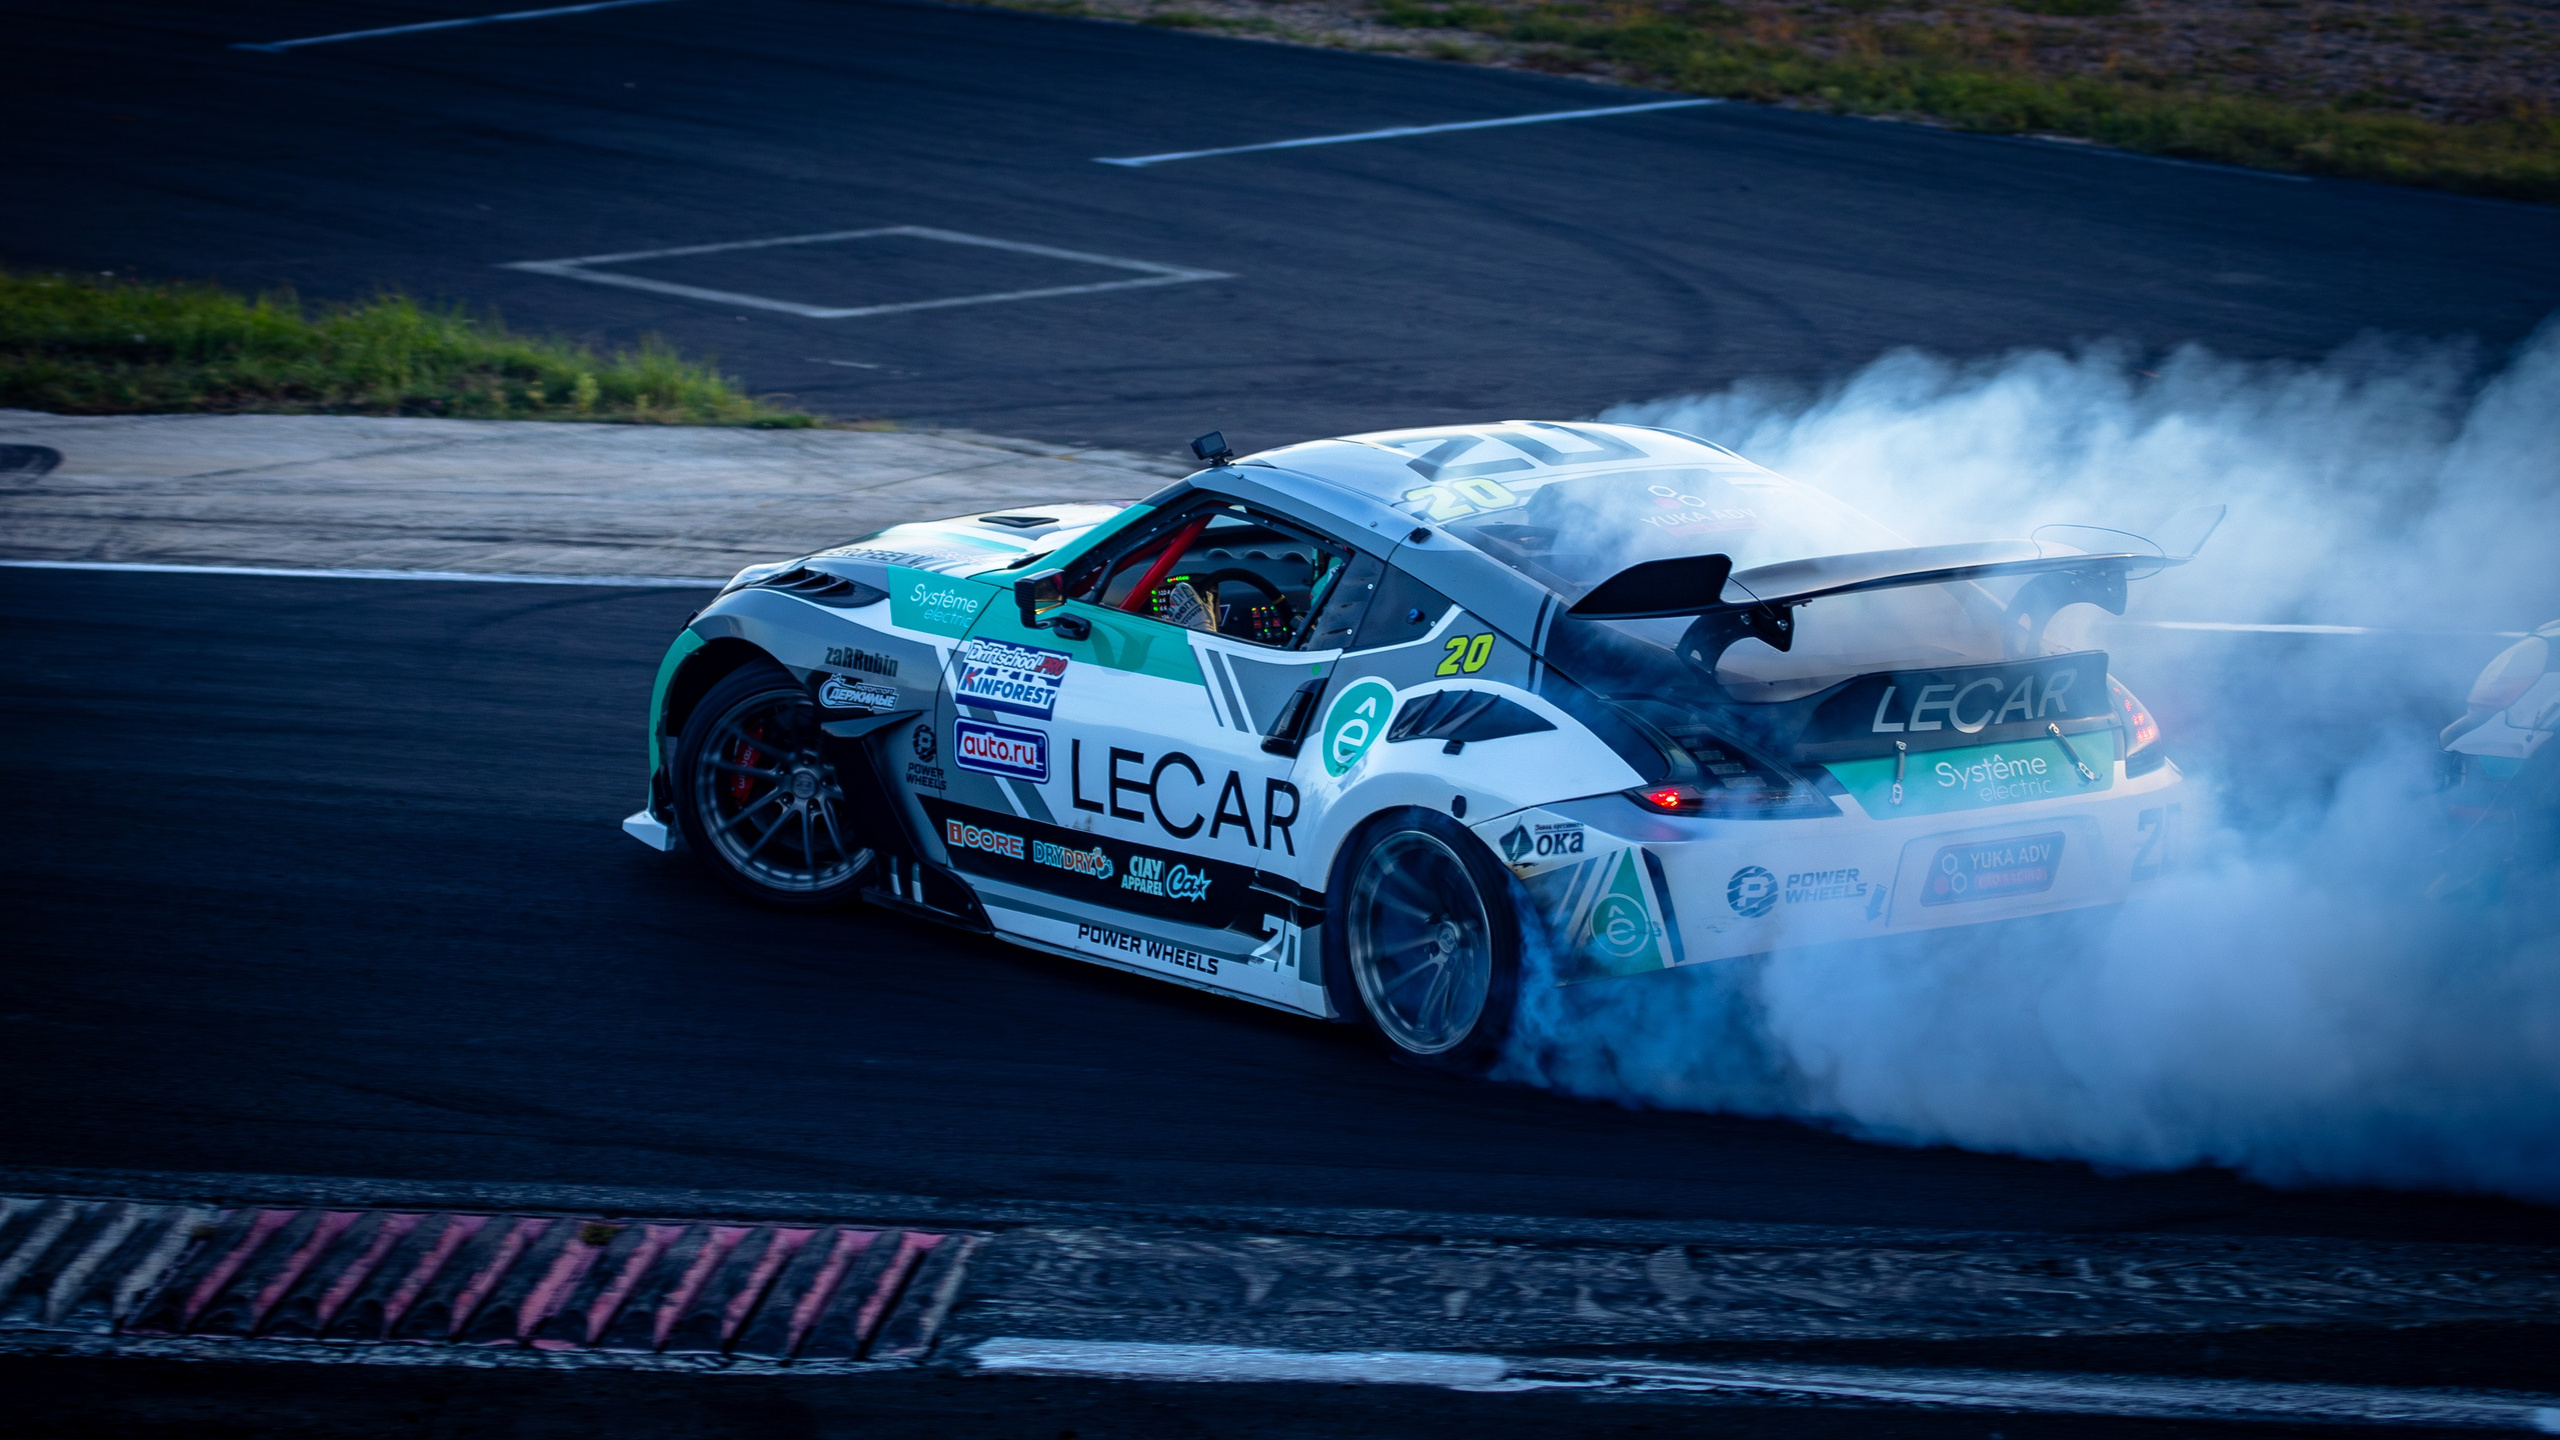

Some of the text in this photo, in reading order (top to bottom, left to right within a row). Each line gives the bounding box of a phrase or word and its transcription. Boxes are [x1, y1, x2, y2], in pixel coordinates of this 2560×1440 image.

[1401, 478, 1517, 522] 20
[1641, 508, 1758, 528] YUKA ADV
[910, 583, 978, 613] Système
[924, 604, 973, 628] electric
[824, 646, 899, 678] zaRRubin
[1435, 632, 1496, 677] 20
[960, 667, 1056, 705] KINFOREST
[1872, 669, 2078, 734] LECAR
[963, 736, 1035, 765] auto.ru
[906, 773, 947, 790] WHEELS
[908, 762, 944, 778] POWER
[1935, 754, 2047, 790] Système
[1072, 738, 1301, 857] LECAR
[1979, 776, 2053, 801] electric
[1970, 844, 2050, 870] YUKA ADV
[1121, 874, 1163, 896] APPAREL
[1785, 882, 1868, 904] WHEELS
[1786, 868, 1860, 889] POWER
[1078, 923, 1219, 976] POWER WHEELS
